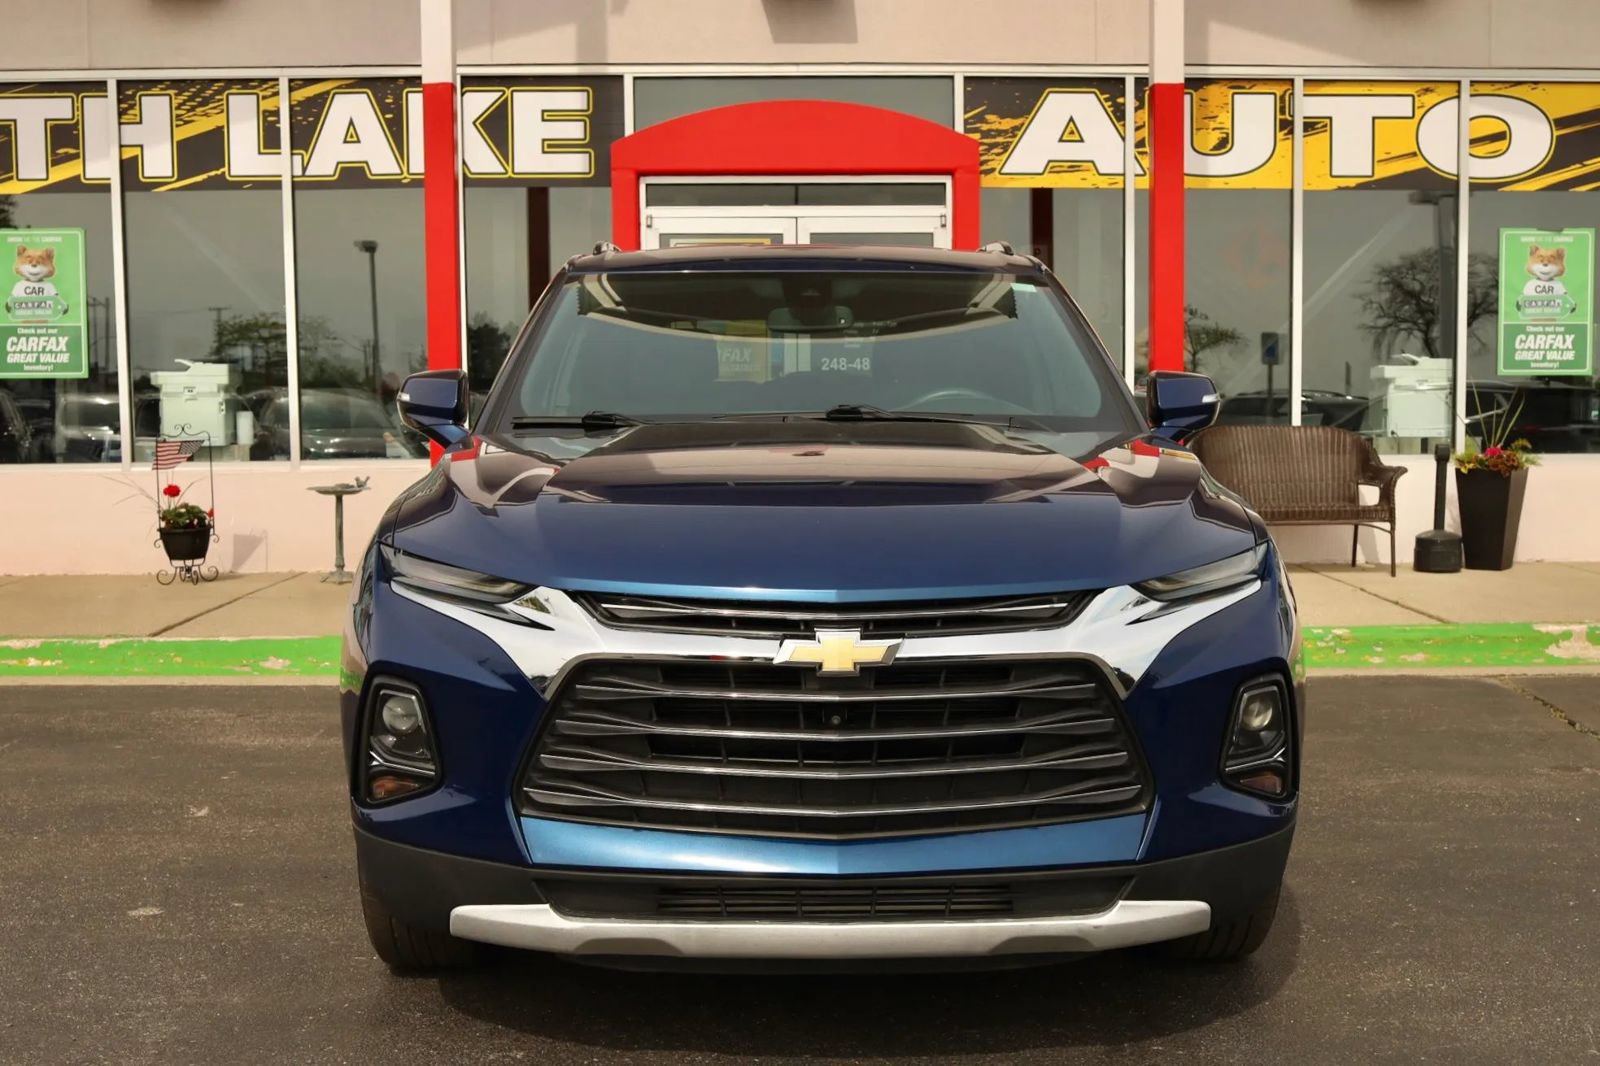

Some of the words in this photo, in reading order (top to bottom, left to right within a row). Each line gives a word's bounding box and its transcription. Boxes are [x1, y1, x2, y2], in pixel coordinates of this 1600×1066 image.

[225, 87, 595, 181] LAKE
[998, 88, 1555, 182] AUTO
[24, 286, 45, 296] CAR
[1534, 285, 1554, 294] CAR
[6, 336, 69, 353] CARFAX
[1515, 334, 1575, 350] CARFAX
[6, 353, 38, 364] GREAT
[39, 353, 70, 364] VALUE
[1514, 350, 1545, 361] GREAT
[1546, 350, 1576, 361] VALUE
